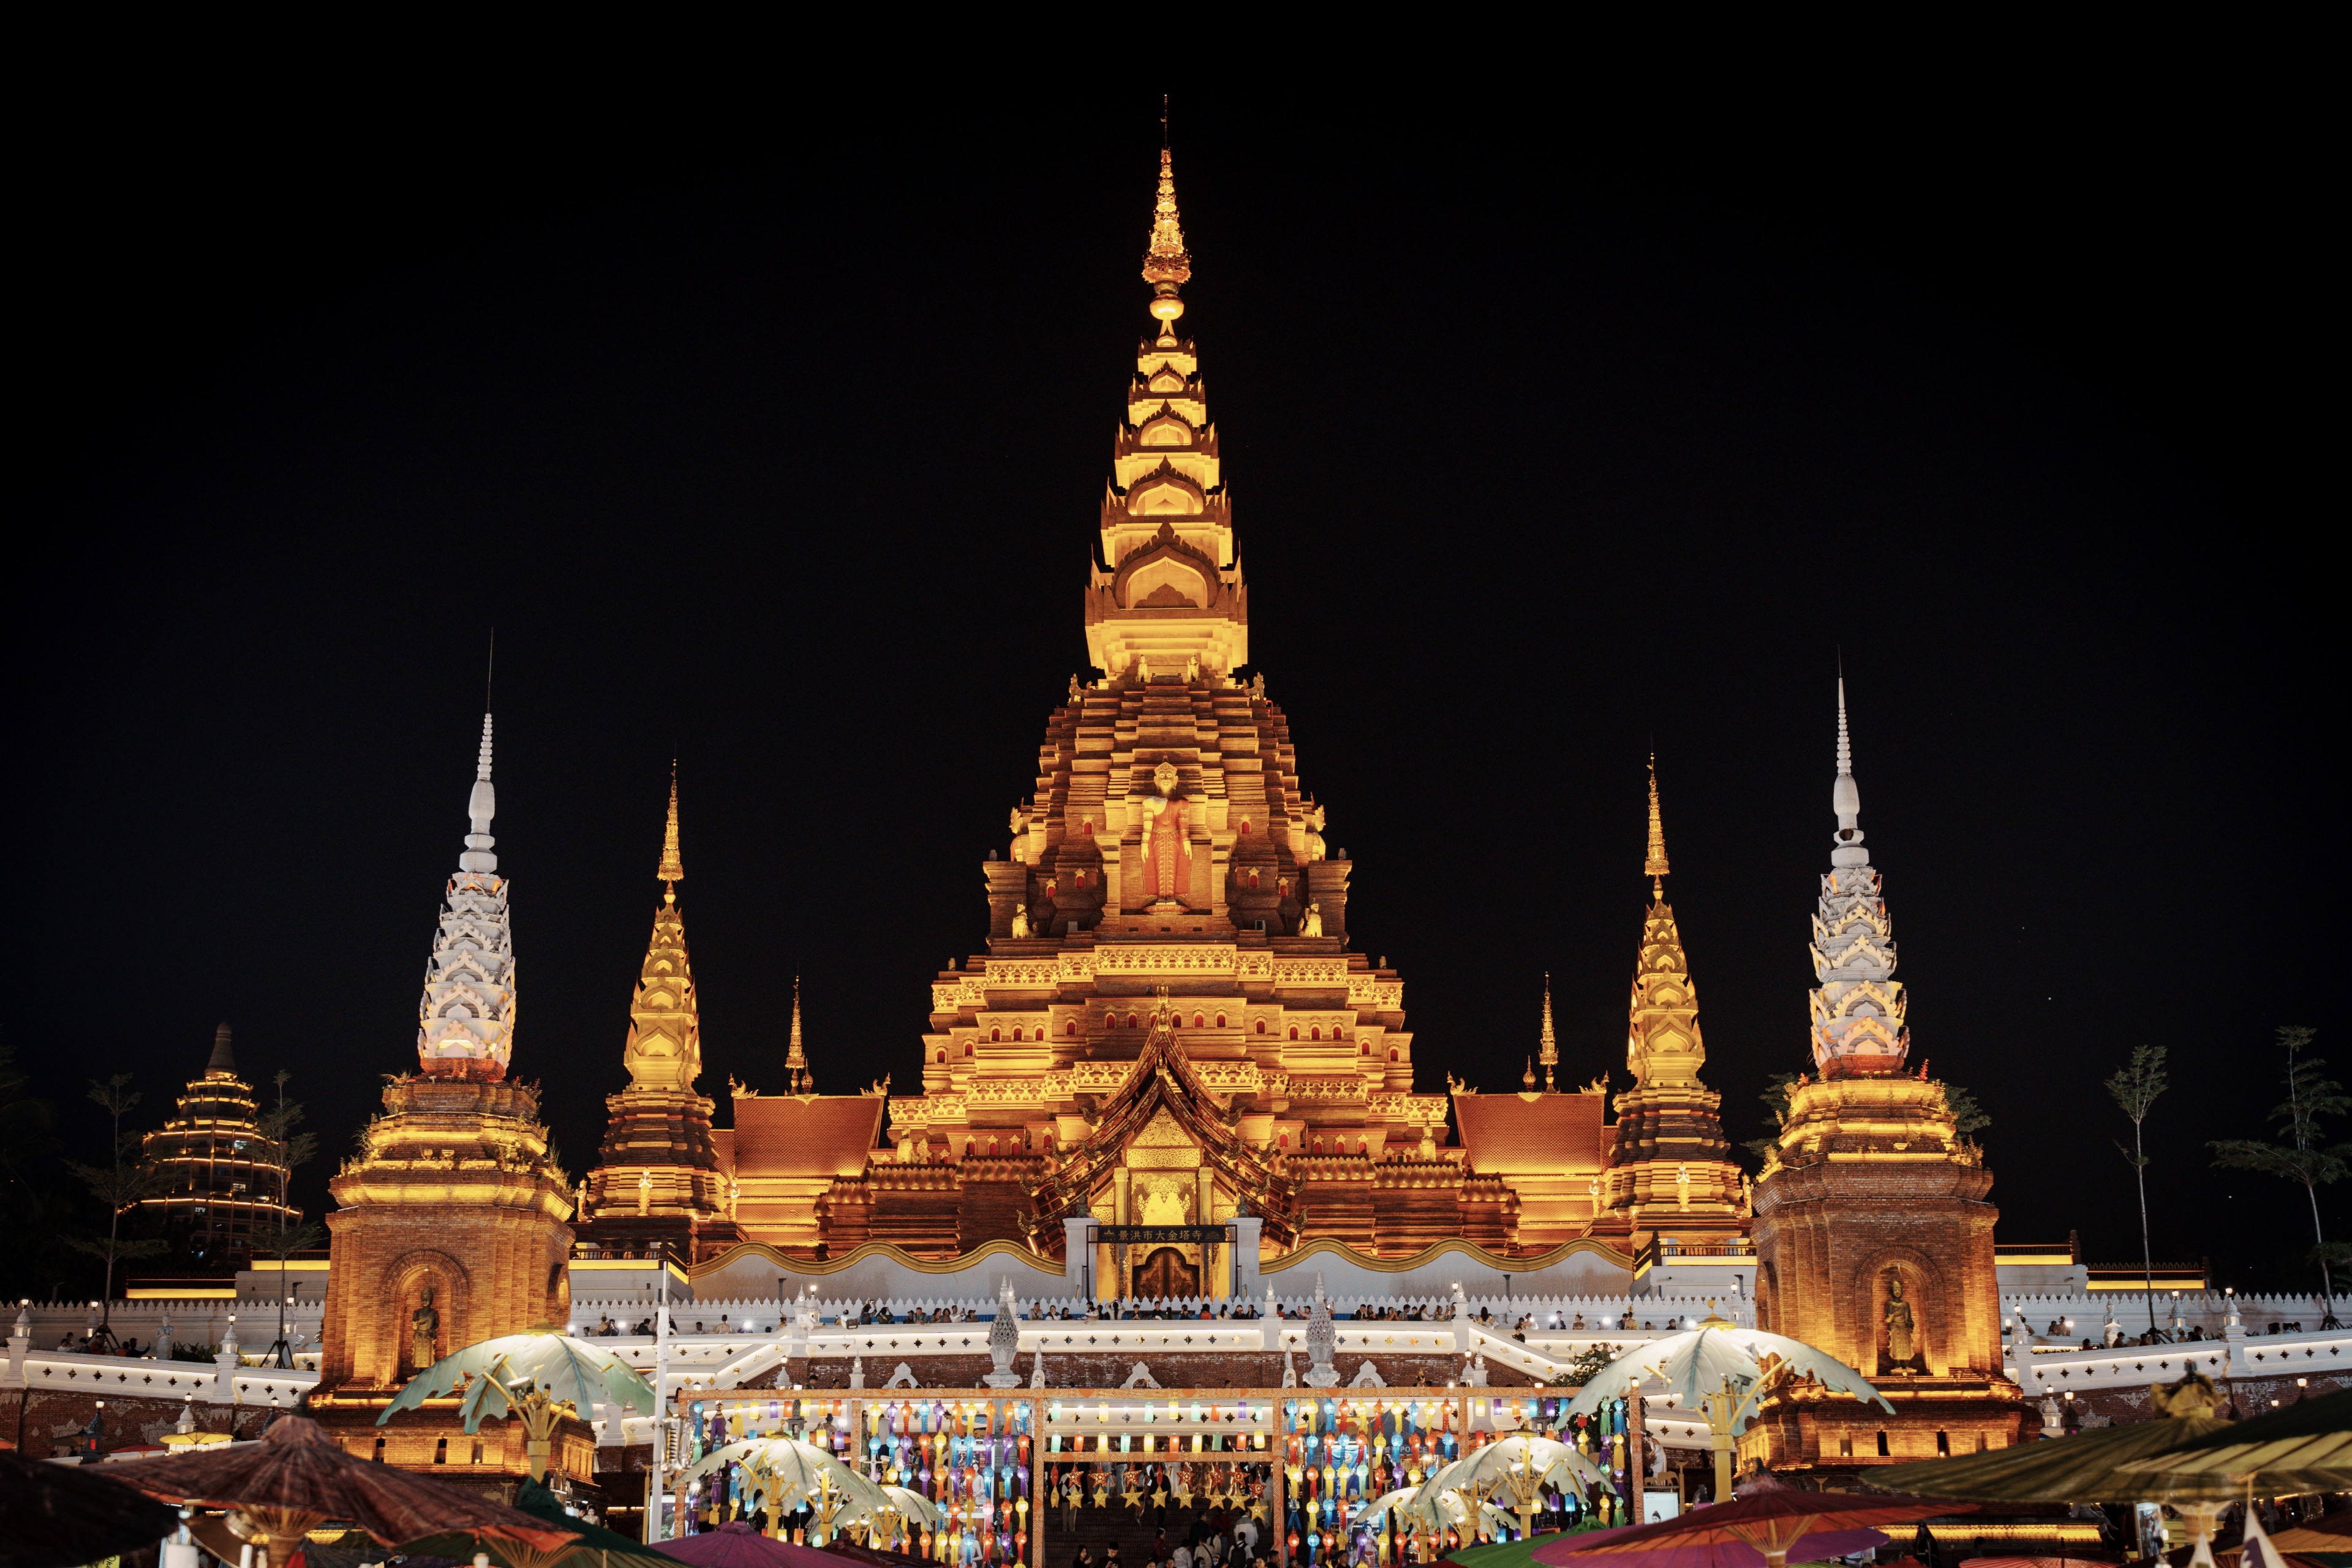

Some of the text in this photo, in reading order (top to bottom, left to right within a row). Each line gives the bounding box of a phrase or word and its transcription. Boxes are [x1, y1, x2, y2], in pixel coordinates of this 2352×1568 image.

[1118, 1230, 1203, 1241] 景洪市大金塔寺
